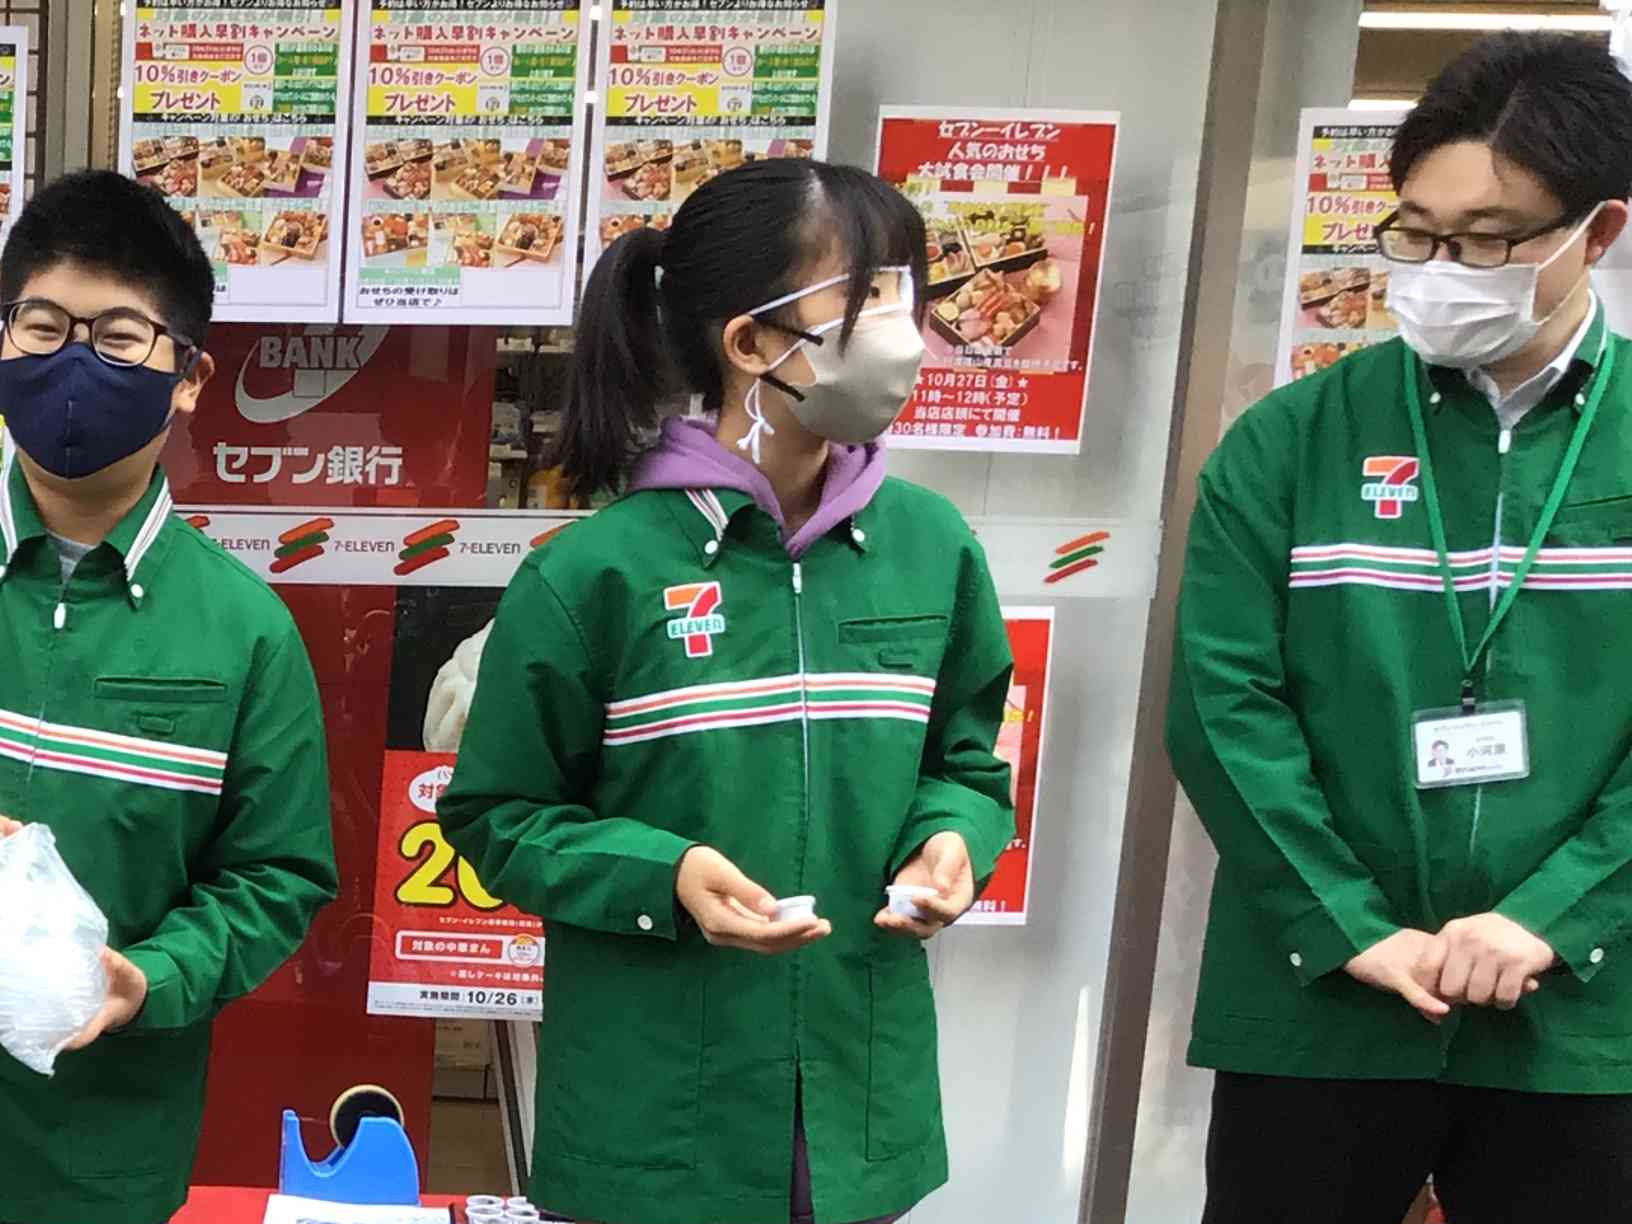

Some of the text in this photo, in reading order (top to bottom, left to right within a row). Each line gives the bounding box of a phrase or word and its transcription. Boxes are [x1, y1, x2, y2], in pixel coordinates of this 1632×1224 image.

[138, 23, 336, 39] ネット購入早割キャンペーン
[374, 26, 573, 40] ネット購入早割キャンペーン
[614, 25, 817, 40] ネット購入早割キャンペーン
[151, 91, 220, 110] プレゼント
[384, 93, 456, 112] プレゼント
[624, 94, 697, 113] プレゼント
[948, 142, 1046, 160] 人気のおせち
[260, 336, 364, 368] BANK
[214, 443, 403, 486] セブン銀行
[468, 990, 518, 1006] 10/26
